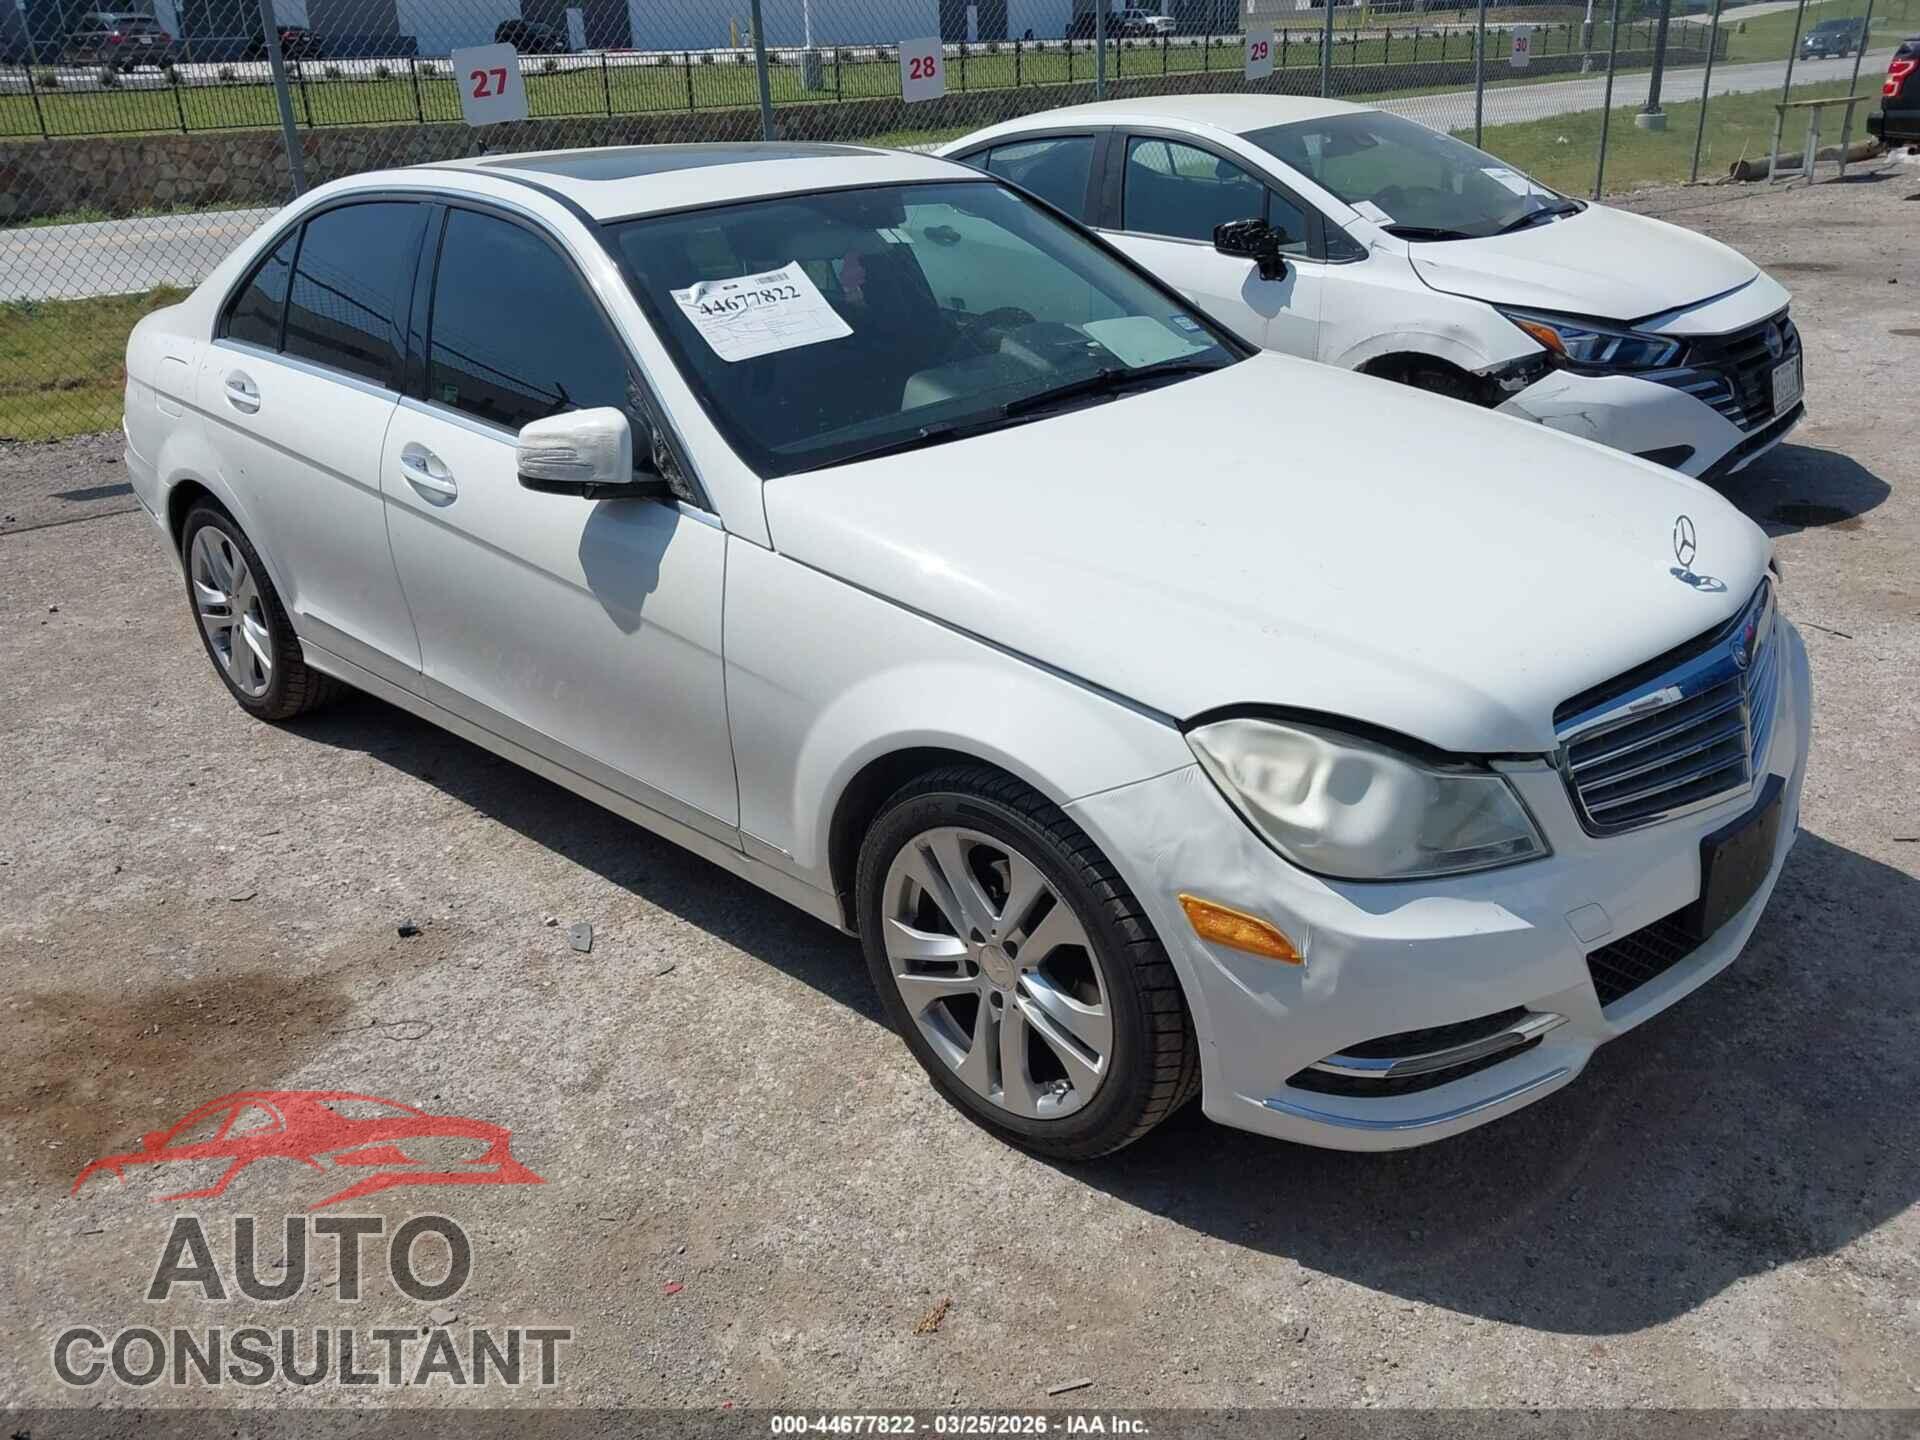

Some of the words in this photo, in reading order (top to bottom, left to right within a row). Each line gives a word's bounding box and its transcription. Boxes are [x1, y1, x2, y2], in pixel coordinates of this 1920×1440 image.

[1250, 41, 1268, 61] 29
[909, 56, 936, 79] 28
[470, 67, 508, 98] 27
[700, 285, 801, 315] 44677822
